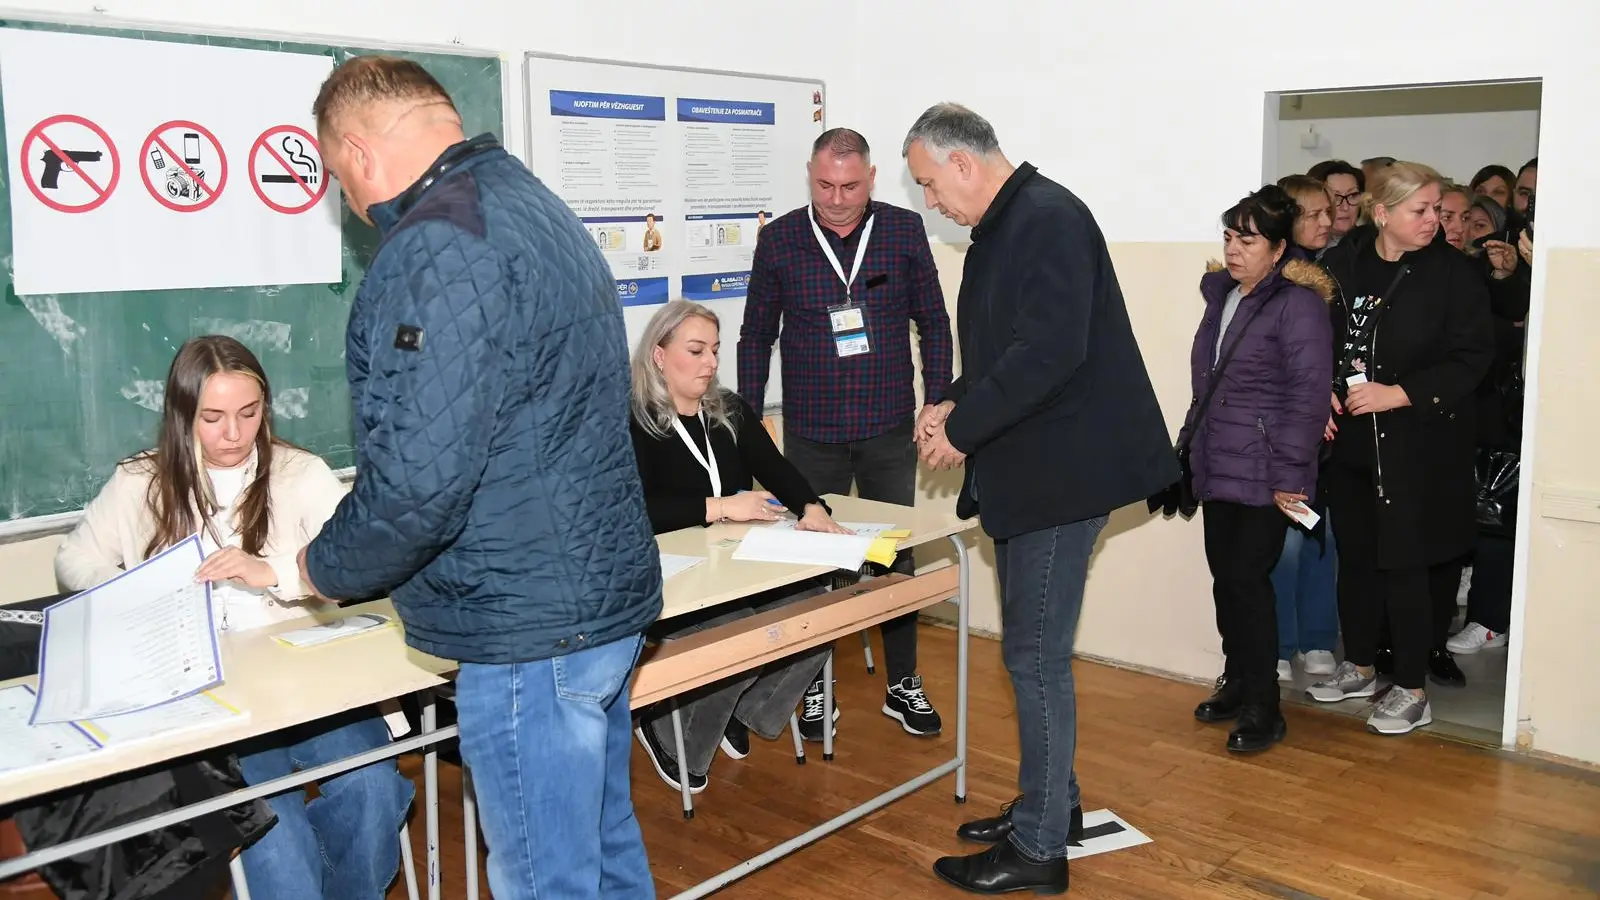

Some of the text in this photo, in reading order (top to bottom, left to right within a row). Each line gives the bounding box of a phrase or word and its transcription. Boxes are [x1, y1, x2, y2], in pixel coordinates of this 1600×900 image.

[573, 100, 645, 111] NJOFTIM PËR VËZHGUESIT
[691, 106, 724, 115] OBAVEŠTENJE
[732, 109, 762, 117] POSMATRAČE
